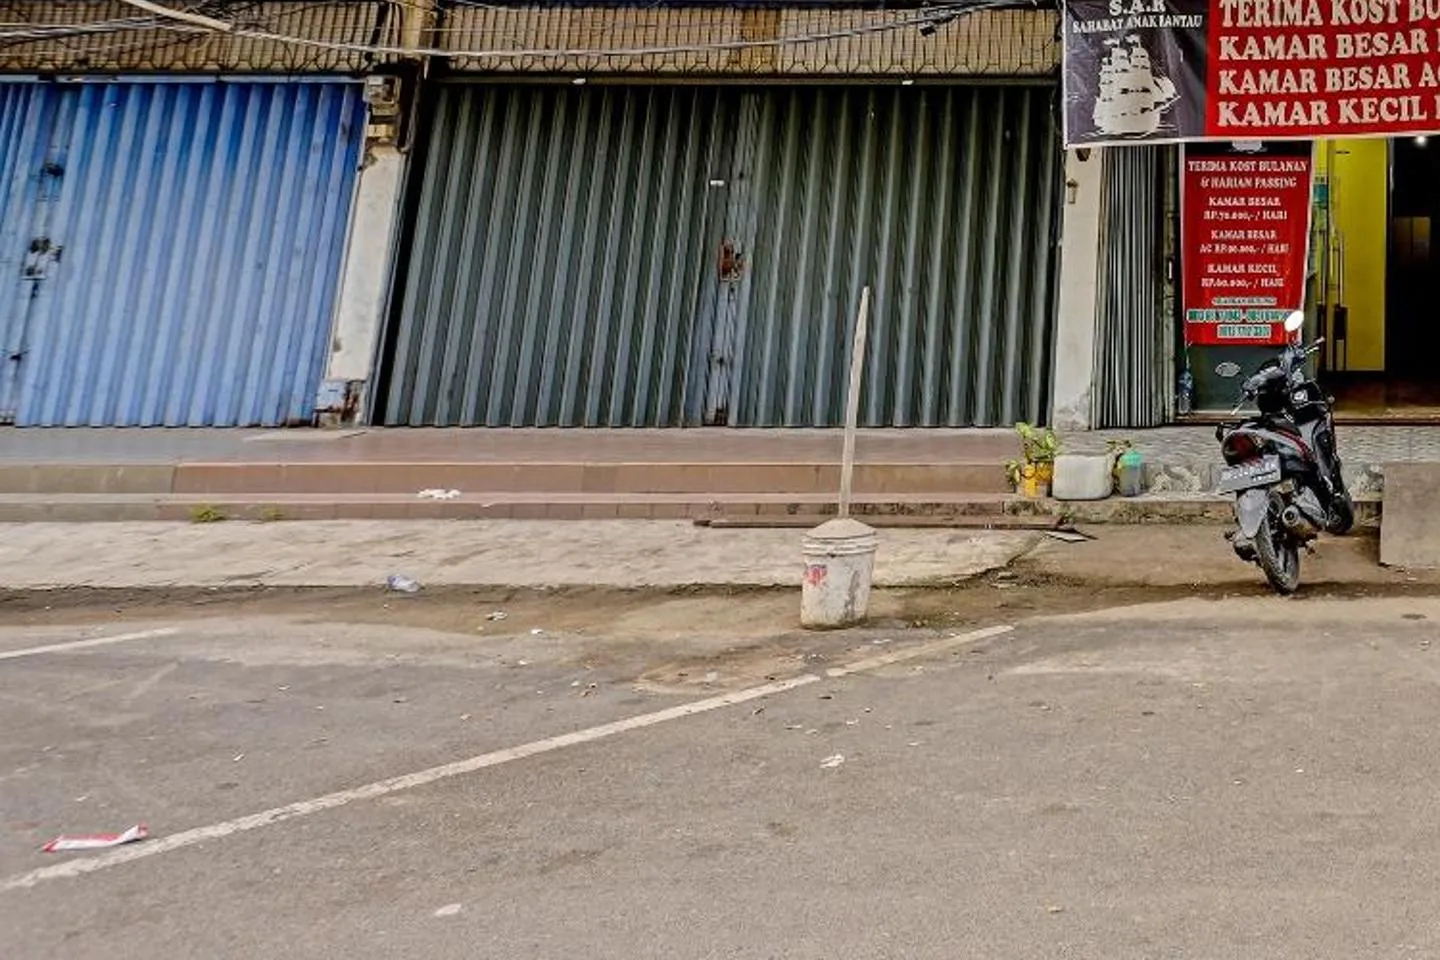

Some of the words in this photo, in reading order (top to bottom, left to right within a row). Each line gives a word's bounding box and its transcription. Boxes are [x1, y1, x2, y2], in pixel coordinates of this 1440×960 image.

[1125, 15, 1157, 28] ANAK
[1219, 34, 1327, 60] KAMAR
[1336, 28, 1429, 58] BESAR
[1218, 68, 1318, 94] KAMAR
[1325, 63, 1411, 91] BESAR
[1217, 100, 1330, 126] KAMAR
[1338, 96, 1427, 124] KECIL
[1188, 161, 1227, 172] TERIMA
[1229, 161, 1257, 172] KOST
[1259, 161, 1307, 172] BULANAN
[1209, 197, 1246, 206] KAMAR
[1247, 197, 1281, 206] BESAR
